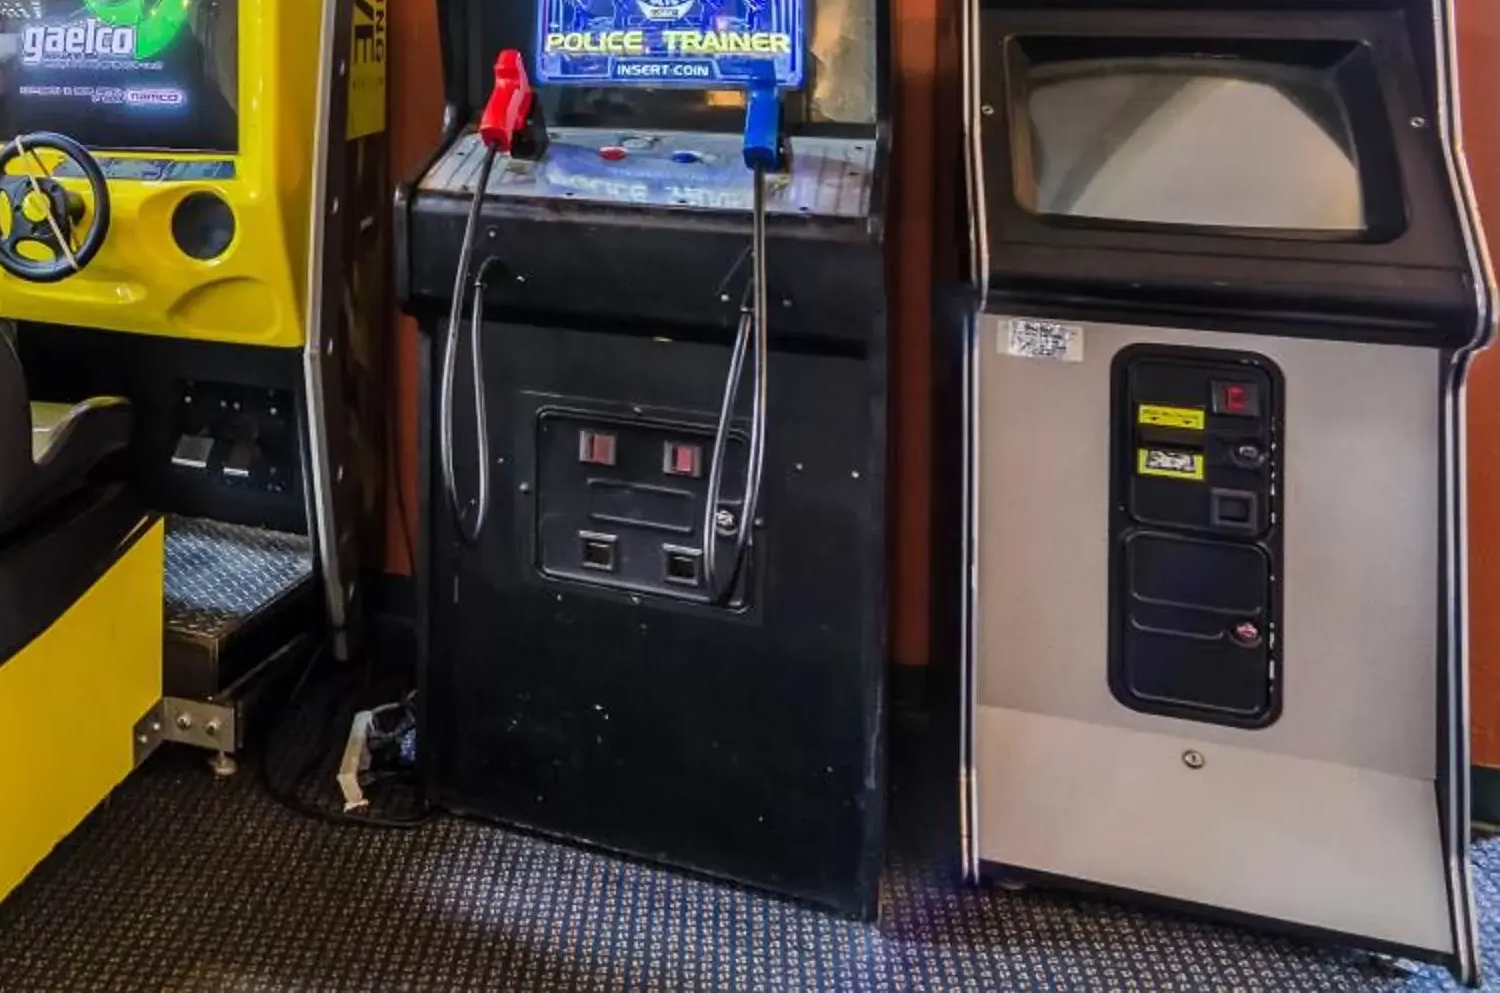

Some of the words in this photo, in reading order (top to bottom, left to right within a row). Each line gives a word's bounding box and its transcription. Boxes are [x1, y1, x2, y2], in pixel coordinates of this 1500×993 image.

[23, 19, 135, 65] gaelco
[547, 31, 645, 54] POLICE
[663, 30, 791, 54] TRAINER
[616, 64, 671, 77] INSERT
[674, 64, 709, 77] COIN
